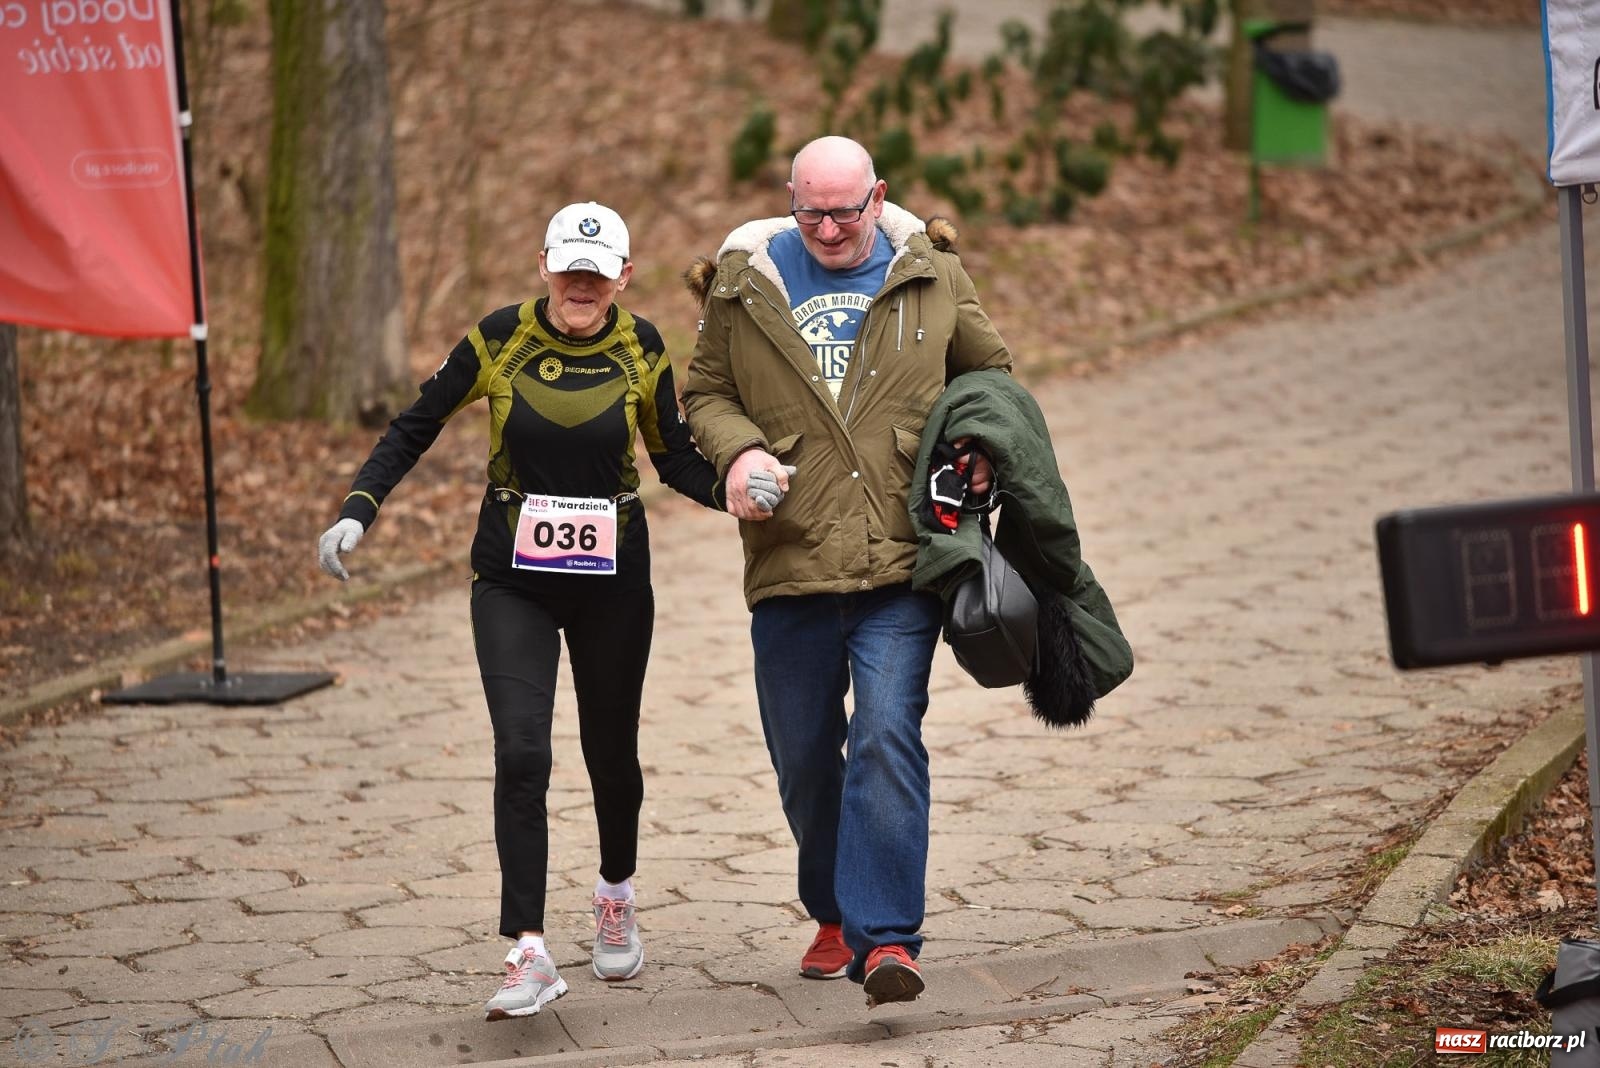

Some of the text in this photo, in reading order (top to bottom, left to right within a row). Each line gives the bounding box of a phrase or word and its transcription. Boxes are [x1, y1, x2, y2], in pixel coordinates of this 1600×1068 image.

[795, 298, 827, 322] ORONA
[551, 499, 609, 511] Twardziela
[533, 521, 597, 551] 036
